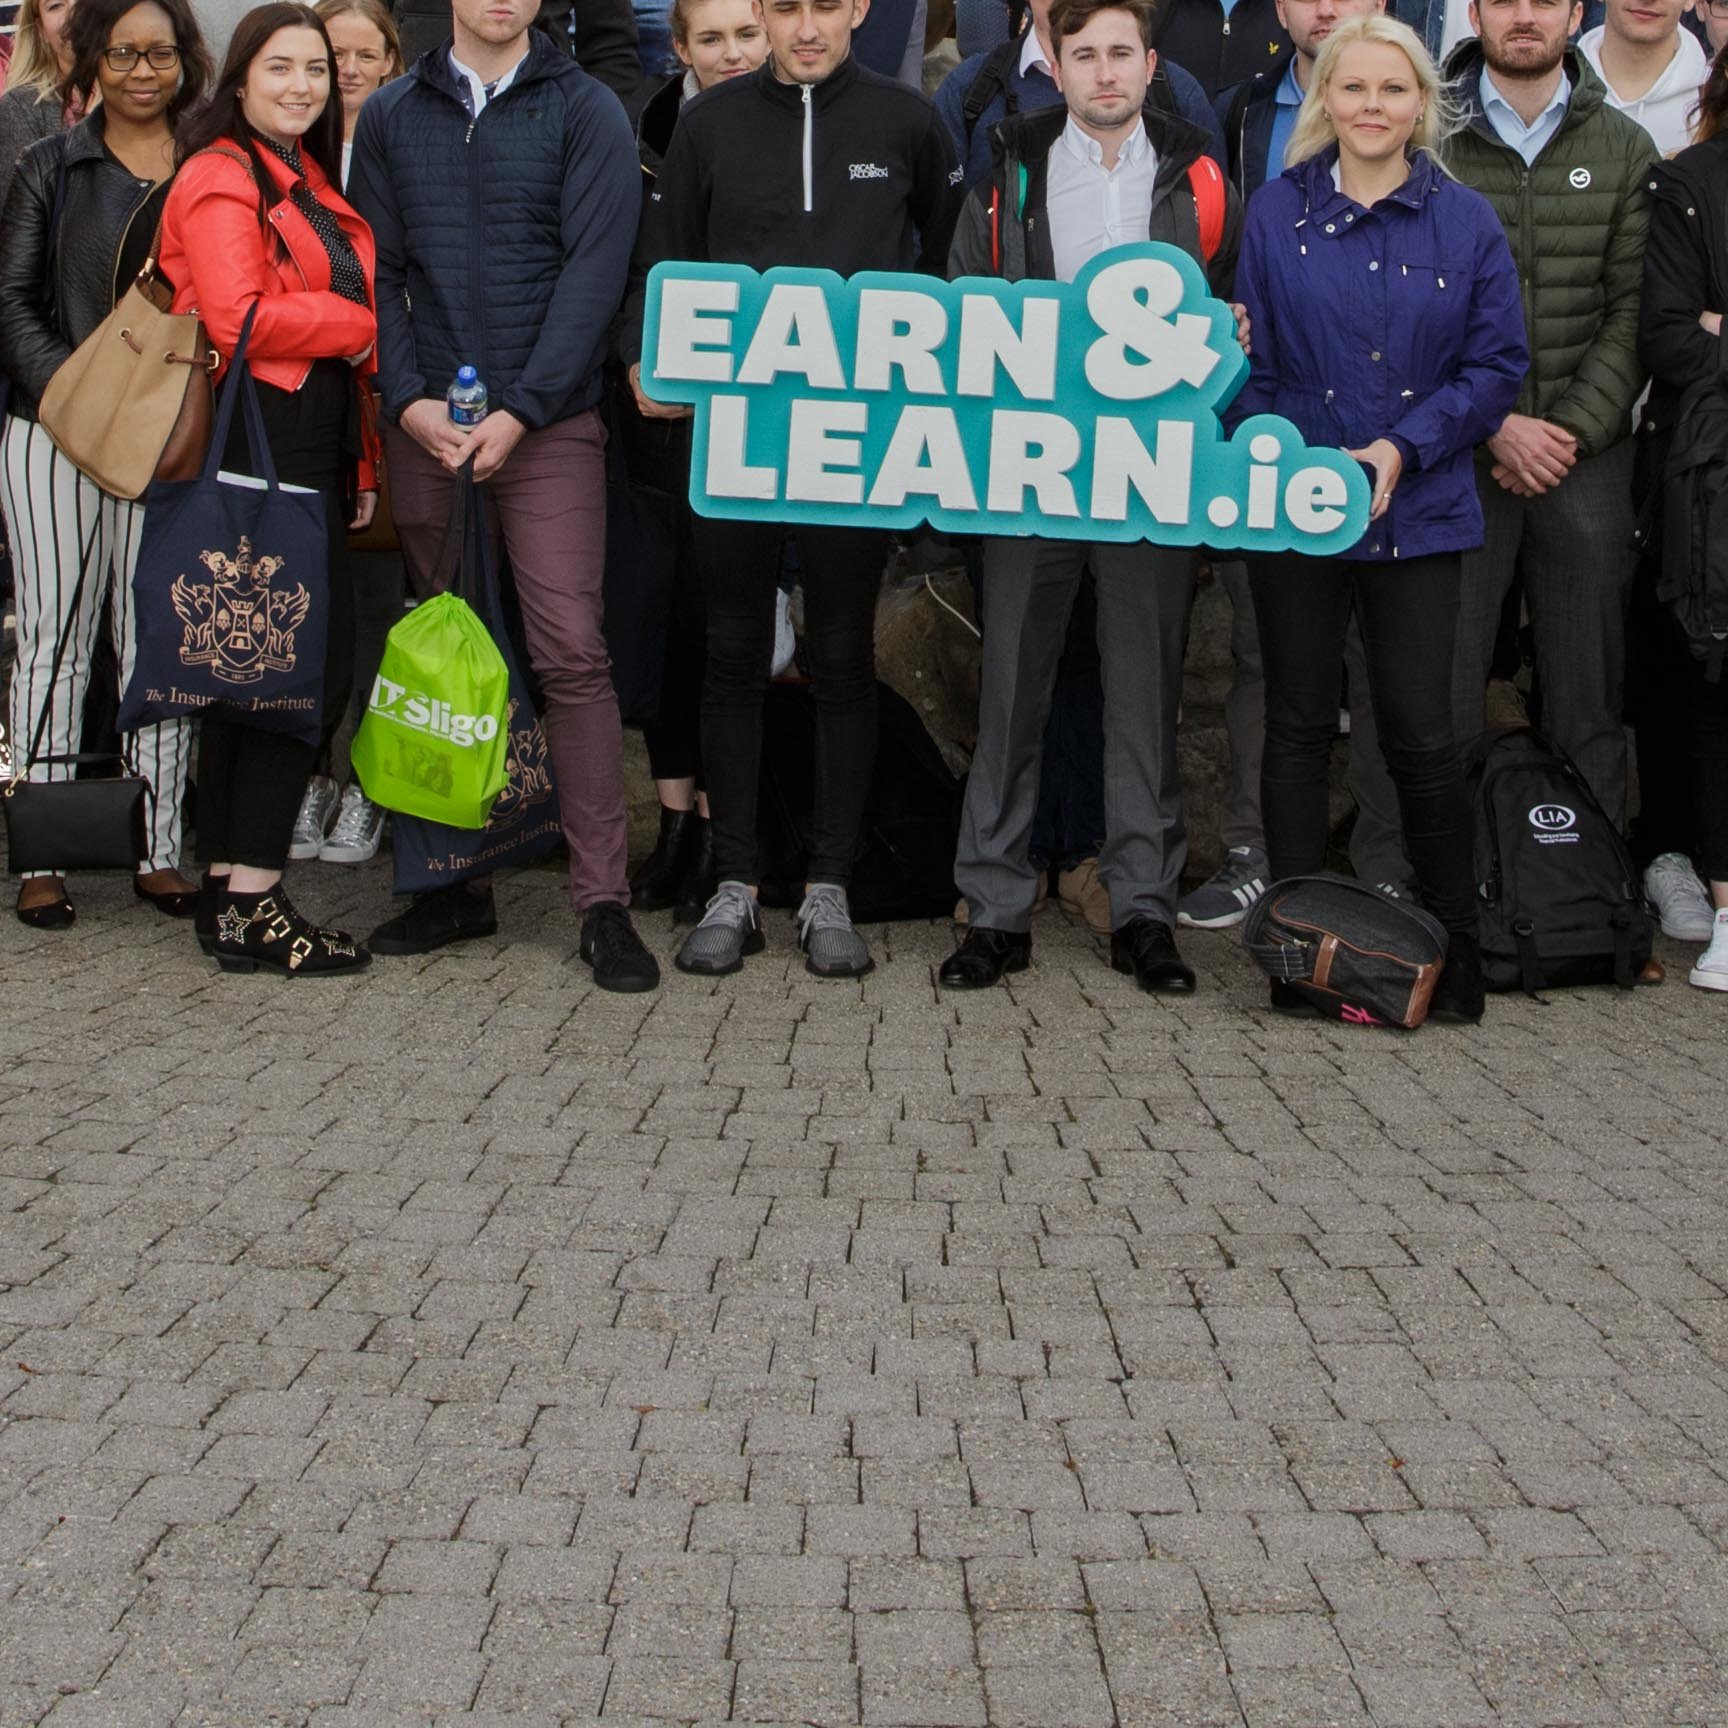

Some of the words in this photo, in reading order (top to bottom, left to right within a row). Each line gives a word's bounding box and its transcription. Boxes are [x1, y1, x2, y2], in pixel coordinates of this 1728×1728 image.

[655, 277, 1060, 401] EARN
[705, 394, 1348, 534] LEARN.ie
[145, 688, 165, 702] The
[369, 673, 406, 708] IT
[403, 692, 498, 747] Sligo
[1537, 810, 1568, 823] LIA
